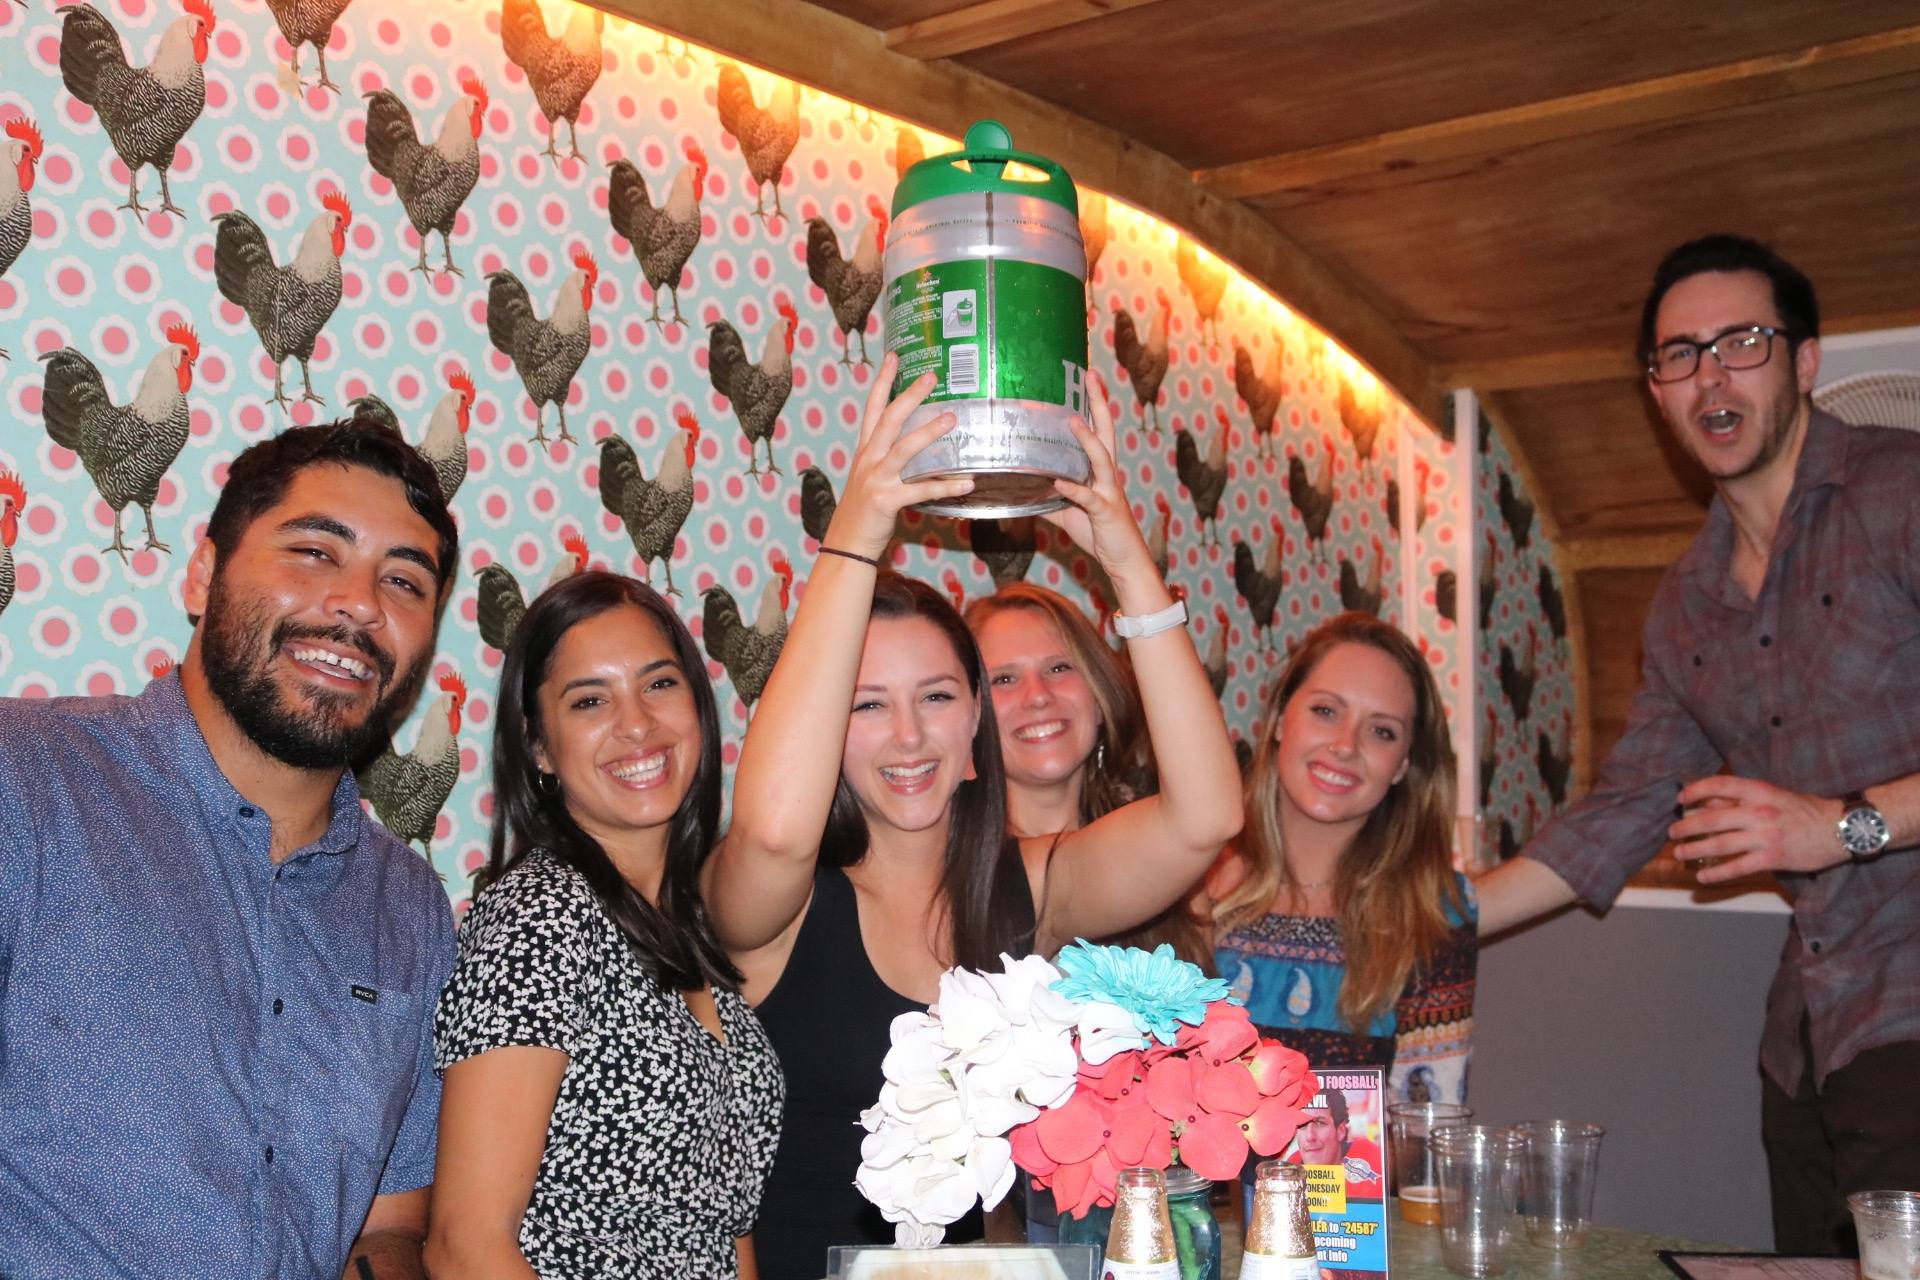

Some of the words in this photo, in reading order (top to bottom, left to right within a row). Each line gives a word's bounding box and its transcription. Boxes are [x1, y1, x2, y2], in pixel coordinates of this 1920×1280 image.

[355, 989, 373, 999] RVCA
[1325, 1075, 1377, 1090] FOOSBALL
[1307, 1183, 1341, 1194] DNESDAY
[1329, 1222, 1340, 1234] to
[1313, 1236, 1357, 1250] pcoming
[1328, 1249, 1348, 1262] Info
